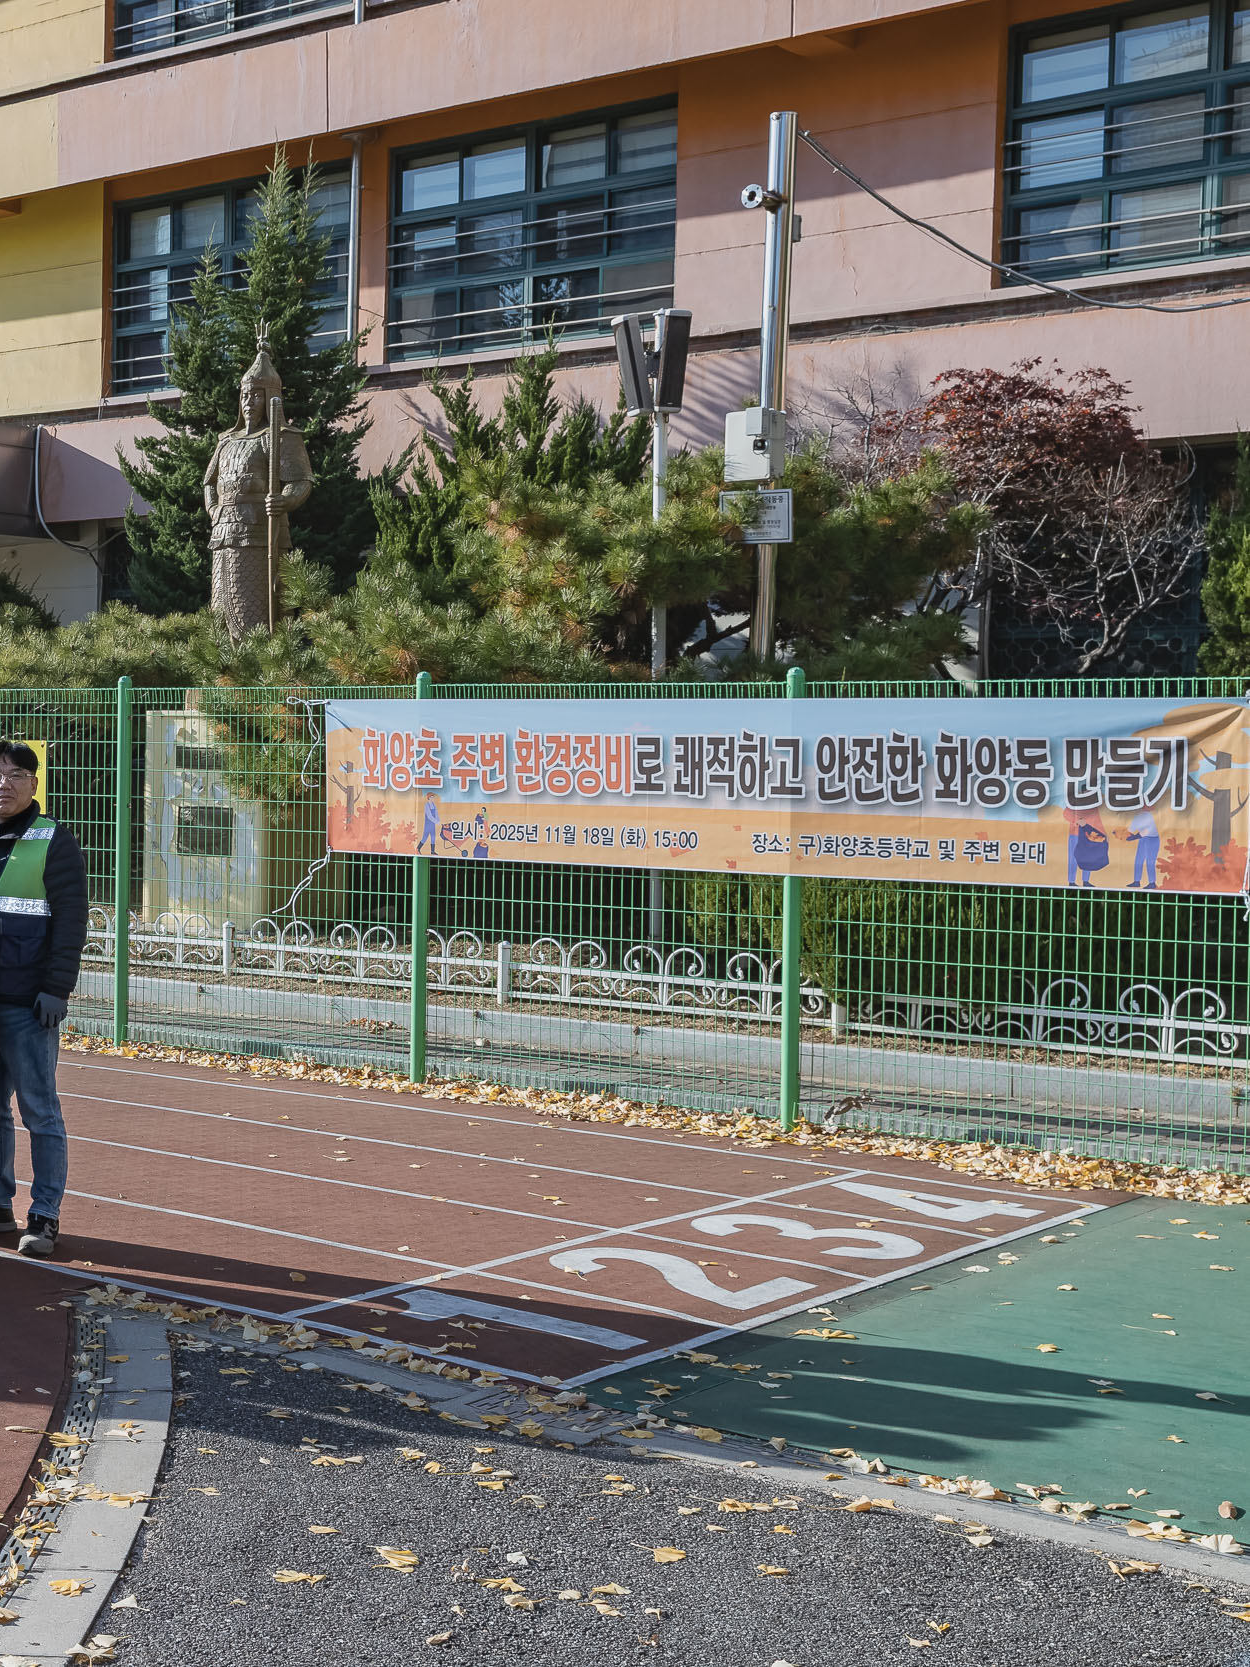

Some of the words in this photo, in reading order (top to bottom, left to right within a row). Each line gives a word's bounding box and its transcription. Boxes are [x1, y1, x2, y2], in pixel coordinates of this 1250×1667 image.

[363, 727, 442, 791] 화양초
[450, 734, 505, 791] 주변
[514, 728, 666, 797] 환경정비로
[674, 730, 805, 798] 쾌적하고
[816, 732, 924, 802] 안전한
[934, 731, 1052, 807] 화양동
[1065, 738, 1187, 809] 만들기
[452, 821, 484, 840] 일시:
[490, 823, 538, 843] 2025년
[545, 825, 576, 845] 11월
[583, 827, 615, 846] 18일
[620, 827, 647, 848] (화)
[653, 830, 699, 849] 15:00
[752, 833, 791, 853] 장소:
[799, 834, 931, 858] 구)화양초등학교
[938, 840, 956, 860] 및
[963, 841, 1000, 862] 주변
[1009, 842, 1047, 865] 일대
[830, 1180, 1046, 1223] 4
[689, 1213, 925, 1260] 3
[549, 1247, 817, 1311] 2
